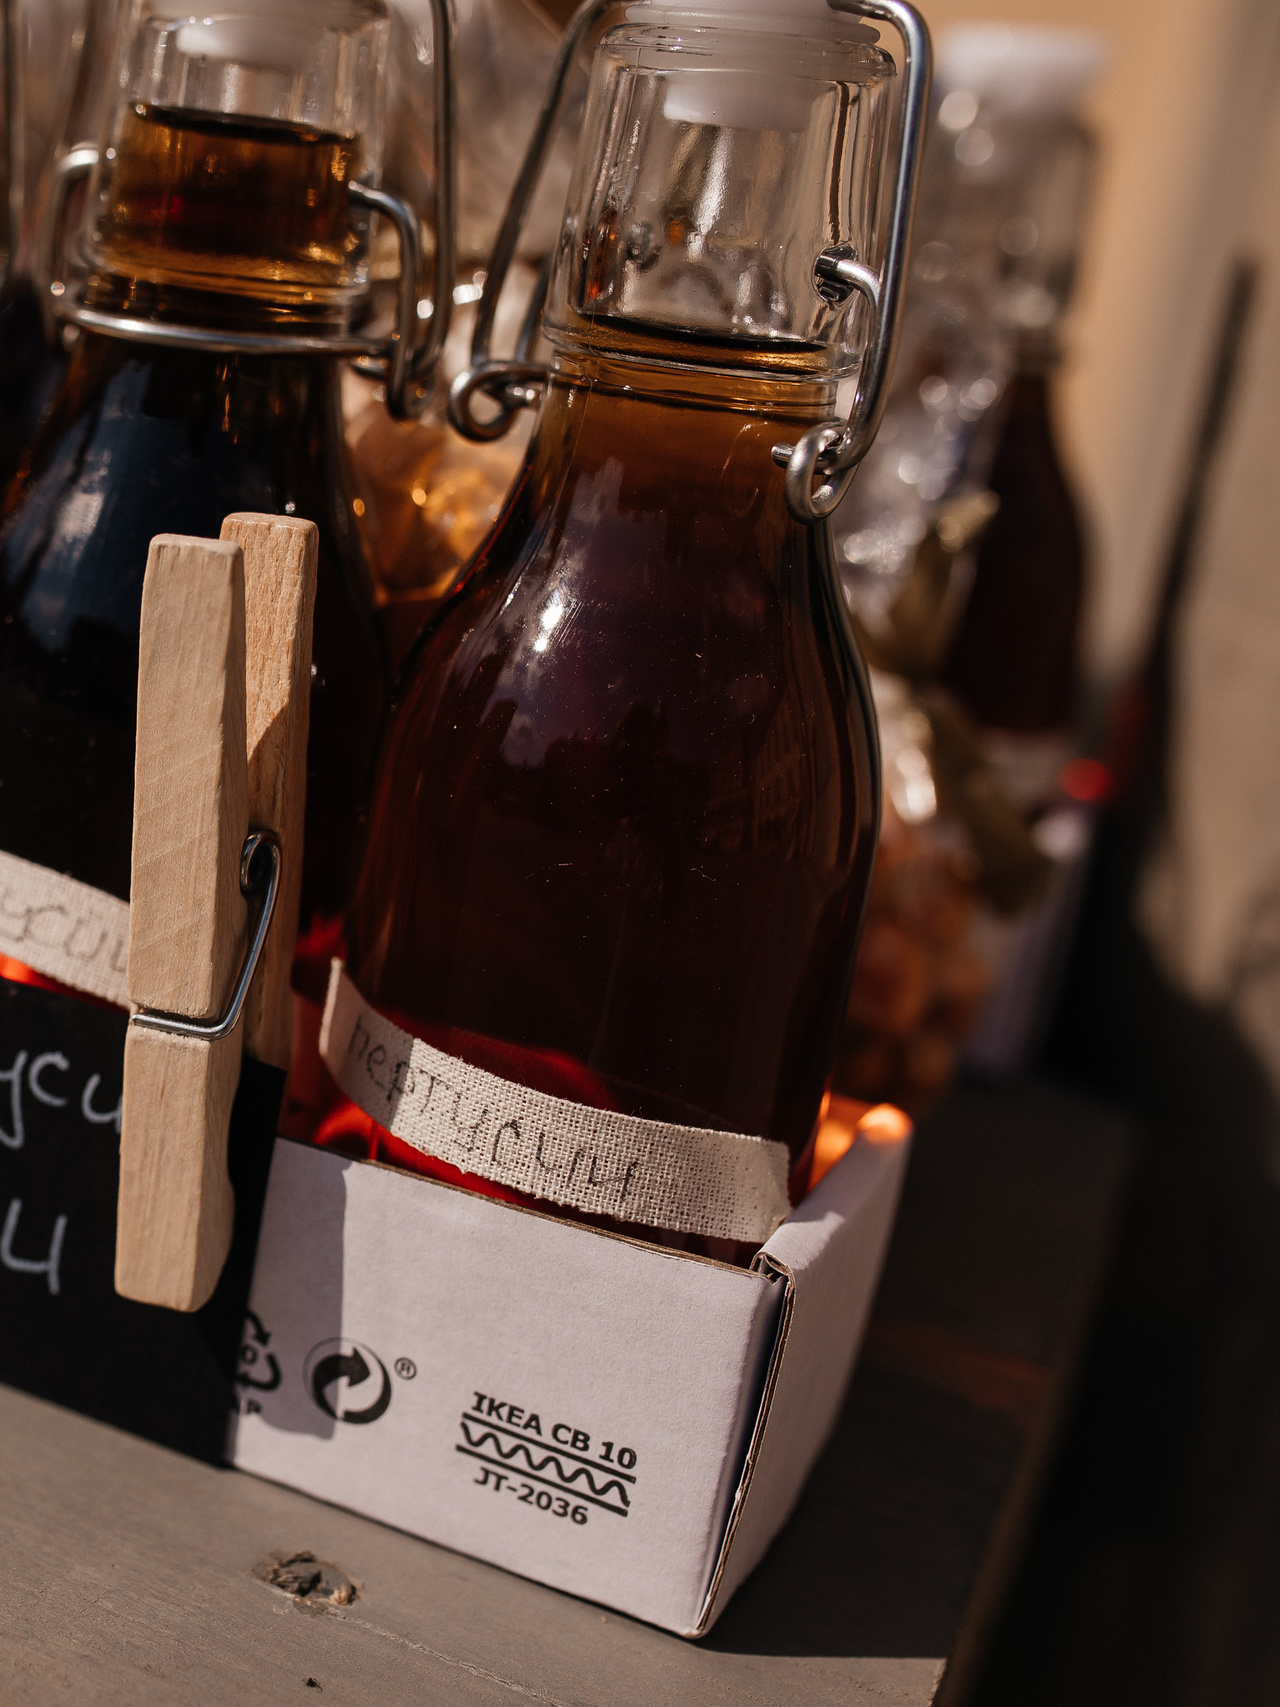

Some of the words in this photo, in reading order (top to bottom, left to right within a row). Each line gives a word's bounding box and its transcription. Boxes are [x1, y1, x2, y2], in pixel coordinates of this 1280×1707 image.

[471, 1390, 543, 1437] IKEA
[551, 1423, 591, 1452] CB
[598, 1441, 638, 1470] 10
[473, 1466, 589, 1526] JT-2036
